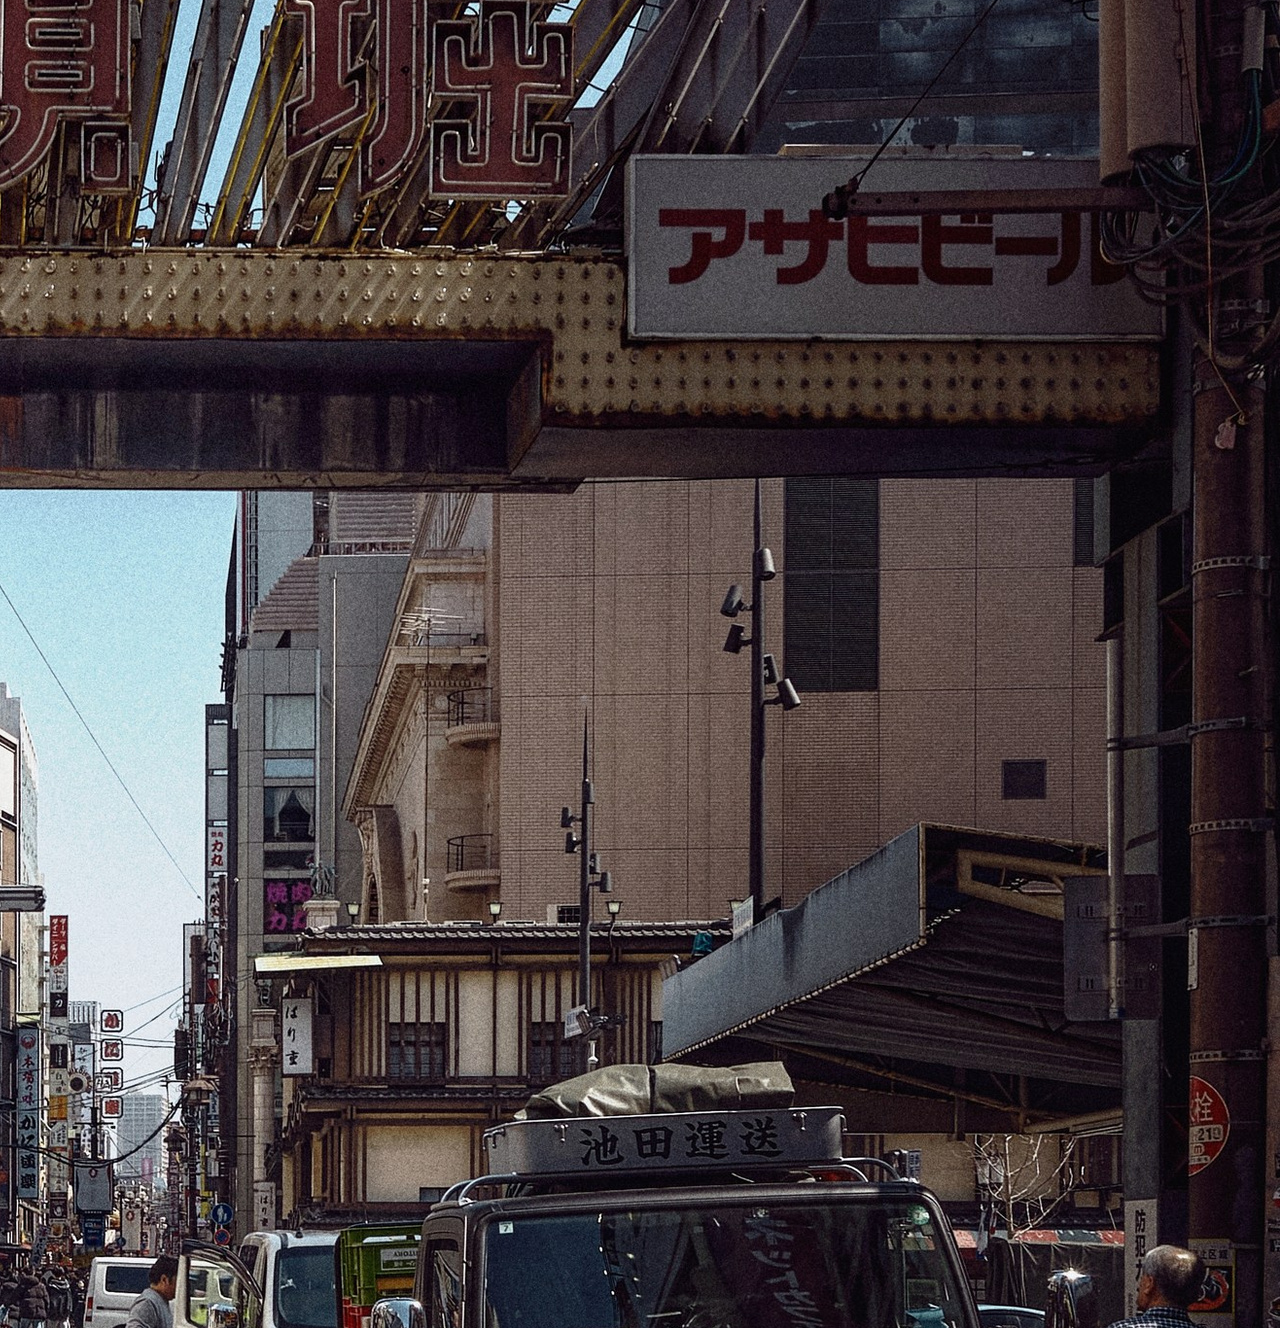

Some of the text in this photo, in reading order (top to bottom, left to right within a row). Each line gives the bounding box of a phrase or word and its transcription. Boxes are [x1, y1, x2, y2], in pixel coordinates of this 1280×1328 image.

[266, 881, 312, 904] 焼肉
[285, 1005, 299, 1066] はり重
[19, 1117, 36, 1191] かに道楽
[580, 1115, 783, 1166] 池田運送
